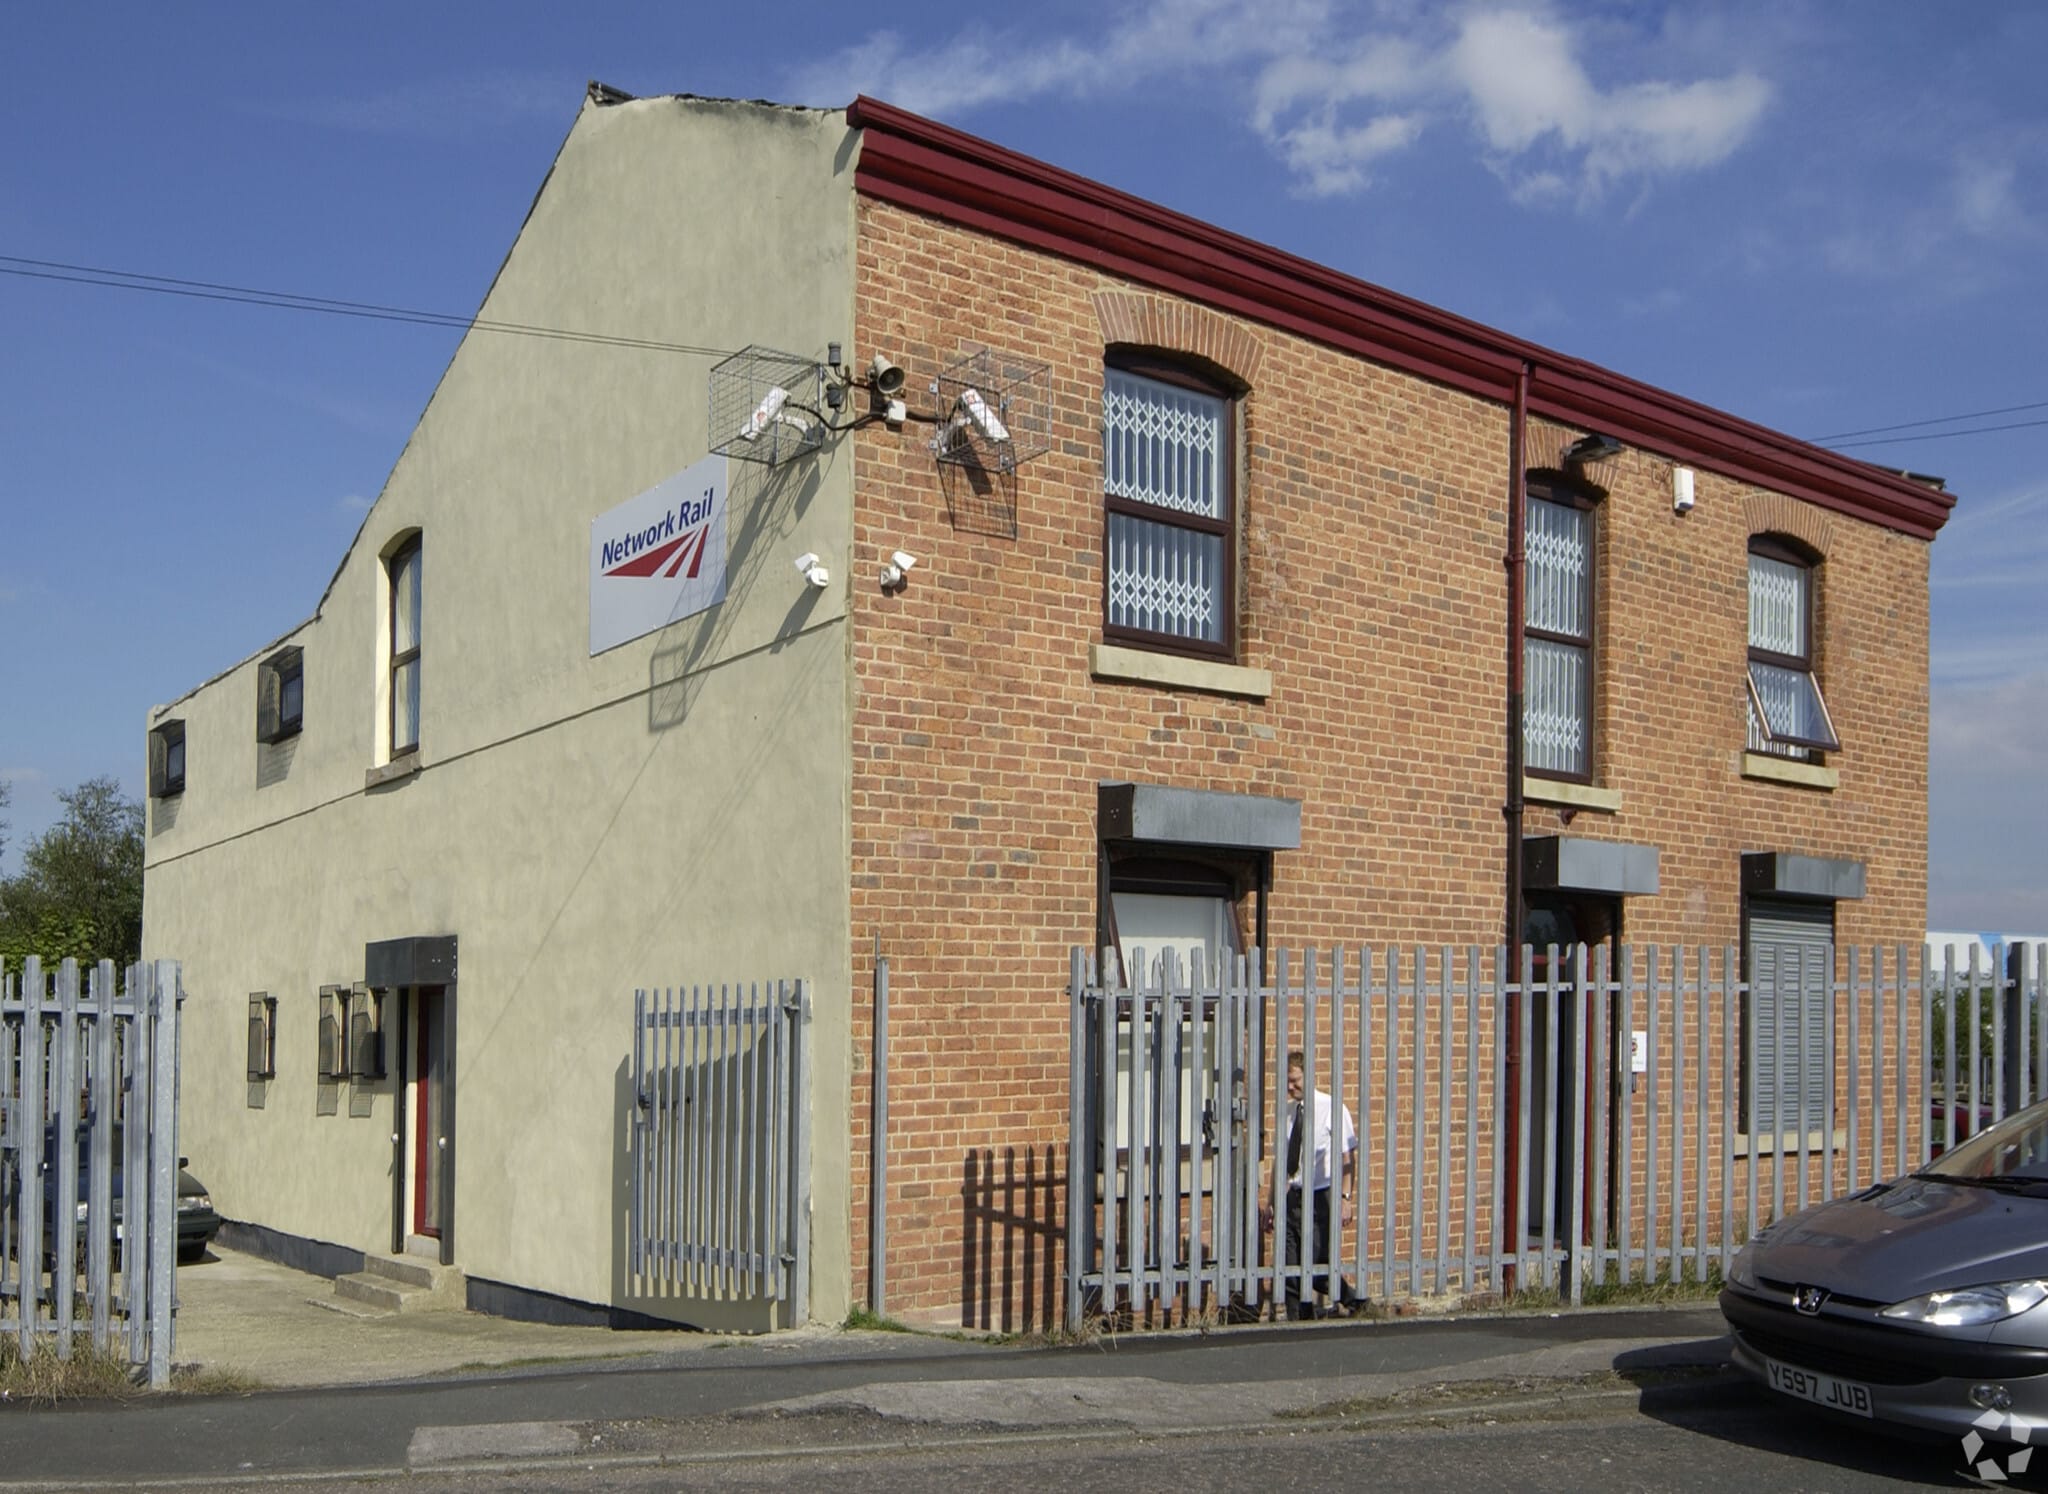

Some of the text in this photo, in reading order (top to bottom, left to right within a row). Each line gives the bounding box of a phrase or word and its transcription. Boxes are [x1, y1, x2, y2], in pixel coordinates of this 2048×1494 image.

[601, 486, 714, 569] Network Rail
[1769, 1362, 1869, 1412] Y597 JUB
